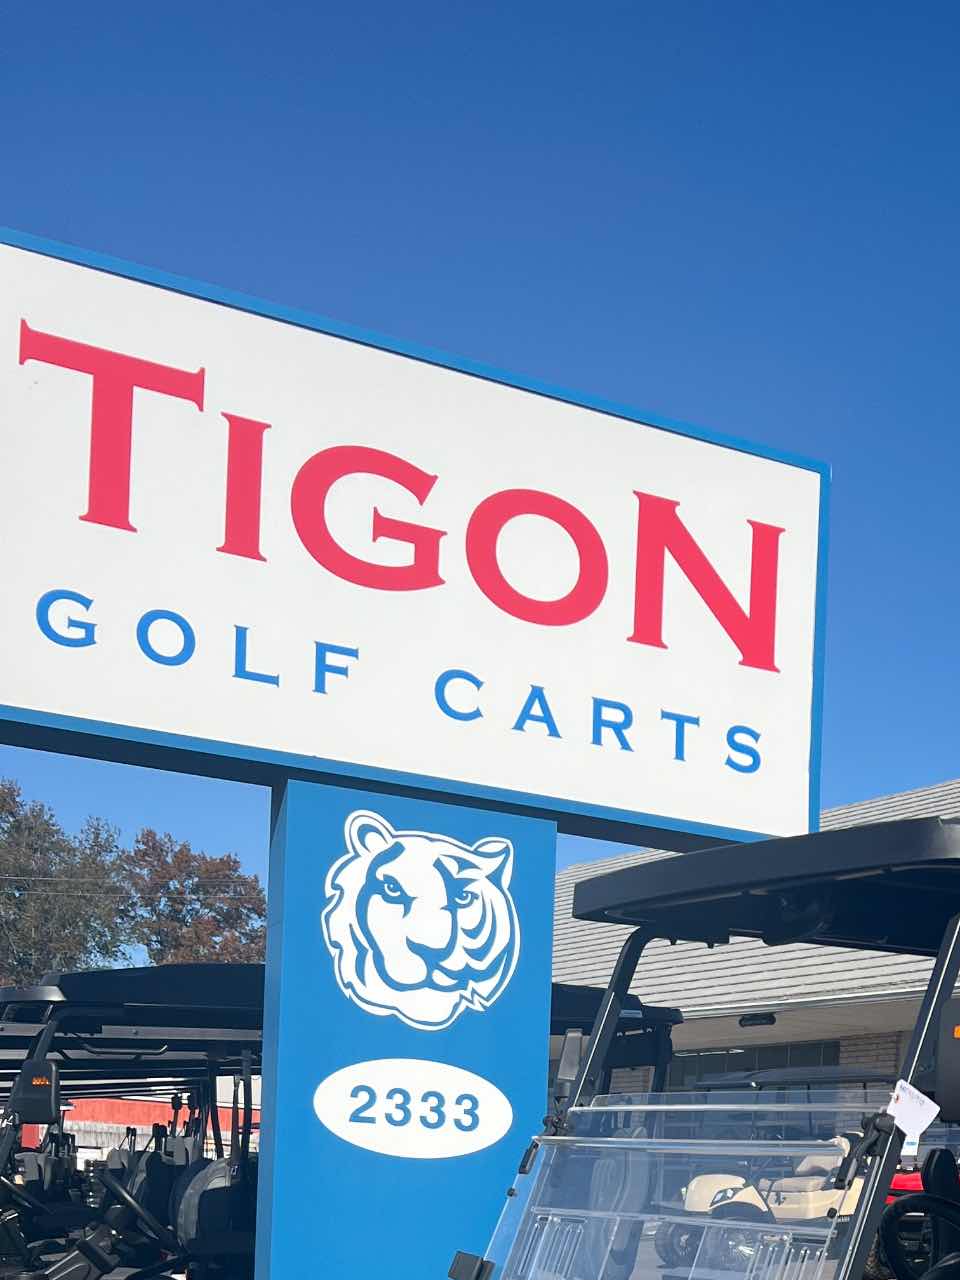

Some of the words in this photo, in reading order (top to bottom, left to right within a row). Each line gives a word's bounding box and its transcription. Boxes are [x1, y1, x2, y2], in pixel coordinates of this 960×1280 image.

[19, 318, 786, 674] TIGON
[35, 588, 360, 695] GOLF
[433, 668, 763, 776] CARTS
[348, 1084, 480, 1132] 2333
